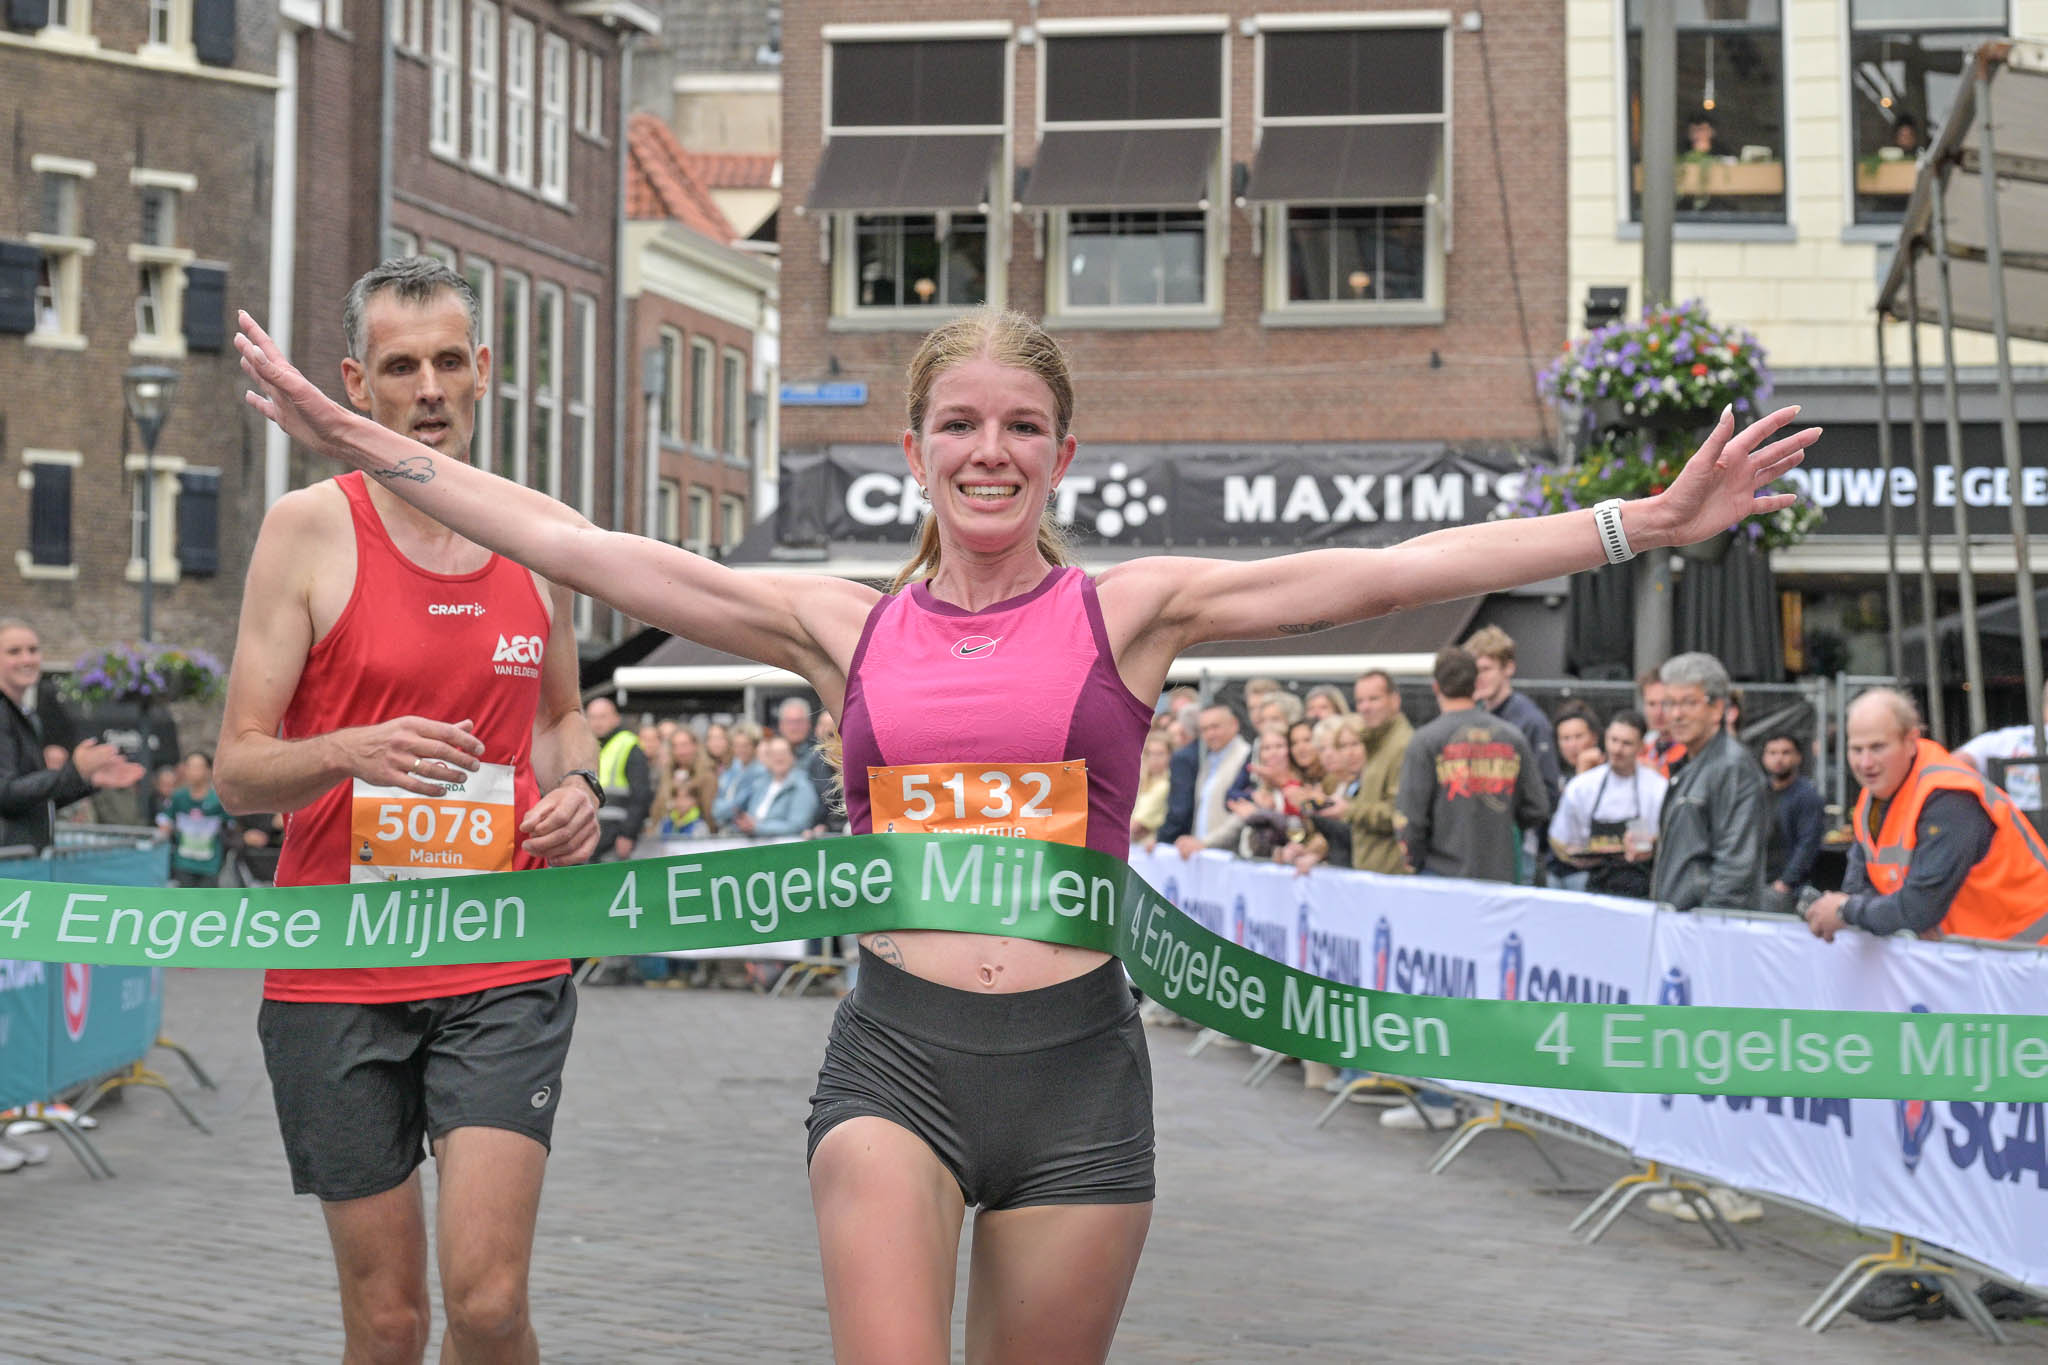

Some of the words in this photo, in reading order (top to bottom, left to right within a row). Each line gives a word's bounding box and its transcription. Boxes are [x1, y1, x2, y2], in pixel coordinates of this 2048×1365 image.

[428, 604, 474, 615] CRAFT
[494, 664, 513, 676] VAN
[902, 771, 1053, 821] 5132
[376, 804, 494, 846] 5078
[409, 848, 463, 865] Martin
[609, 871, 644, 929] 4
[667, 850, 893, 933] Engelse
[921, 842, 1115, 926] Mijlen
[0, 890, 32, 939] 4
[56, 892, 321, 959] Engelse
[345, 888, 526, 958] Mijlen
[1130, 893, 1146, 951] 4
[1140, 904, 1267, 1019] Engelse
[1281, 975, 1450, 1059] Mijlen
[1535, 1012, 1576, 1066] 4
[1602, 1013, 1873, 1085] Engelse
